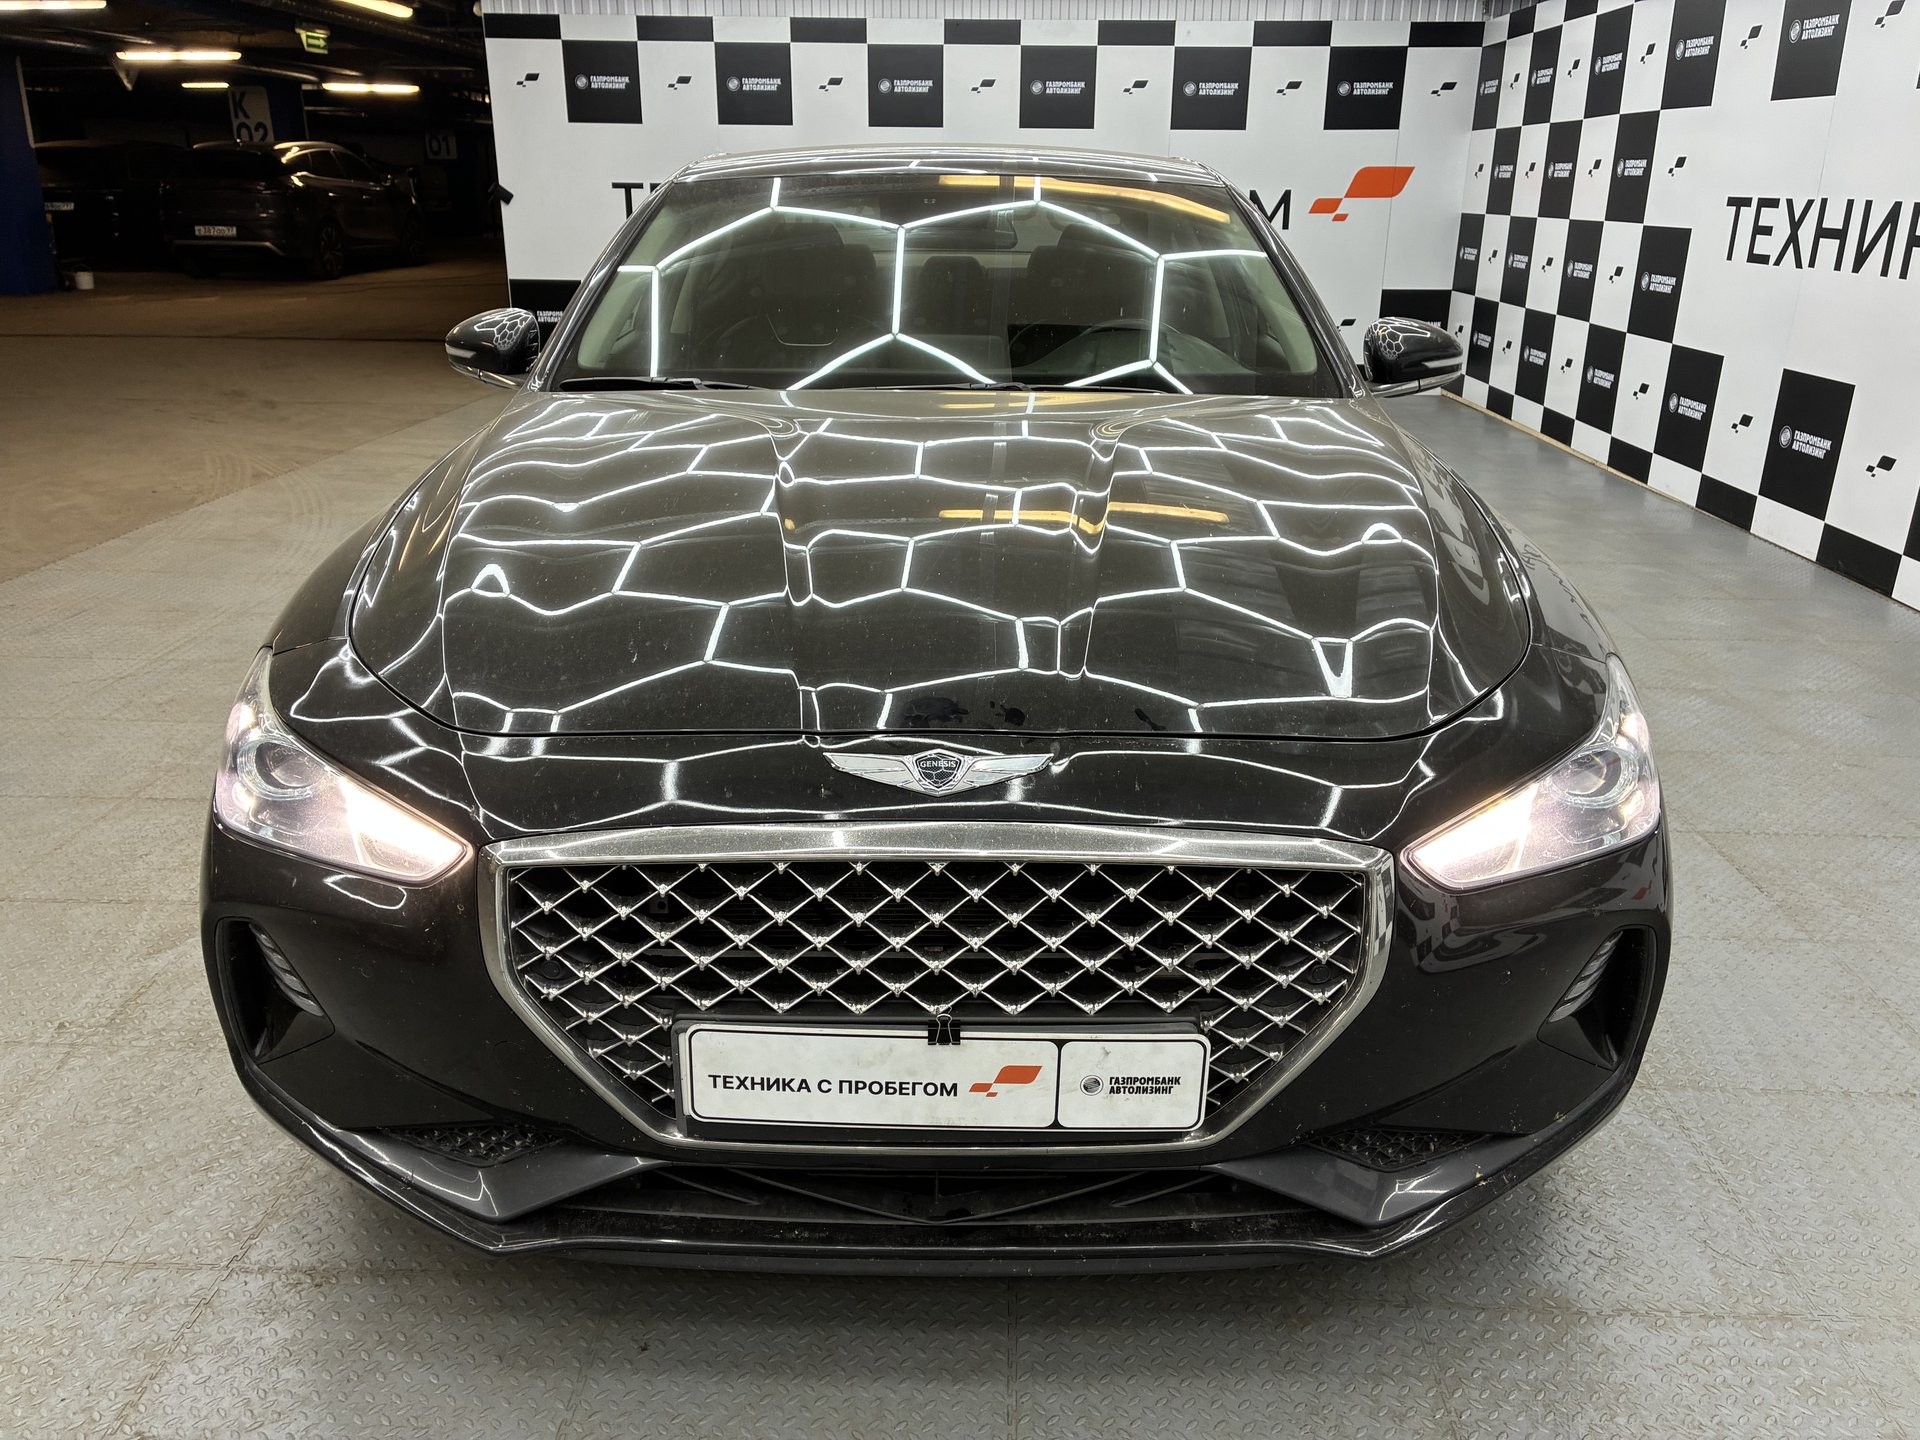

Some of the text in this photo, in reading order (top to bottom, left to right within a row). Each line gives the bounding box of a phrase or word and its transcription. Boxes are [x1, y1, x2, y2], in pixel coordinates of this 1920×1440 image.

[1803, 14, 1840, 29] ГАЗПРОМБАНК
[1802, 26, 1834, 40] АВТОЛИЗИНГ
[1686, 36, 1714, 48] ГАЗПРОМБАНК
[1685, 46, 1710, 57] АВТОЛИЗИНГ
[590, 75, 630, 83] ГАЗПРОМБАНК
[742, 77, 781, 85] ГАЗПРОМБАНК
[894, 79, 933, 87] ГАЗПРОМБАНК
[1045, 80, 1085, 88] ГАЗПРОМБАНК
[1353, 81, 1393, 89] ГАЗПРОМБАНК
[1680, 397, 1707, 413] ГАЗПРОМБАНК
[1678, 405, 1703, 421] АВТОЛИЗИНГ
[1794, 430, 1832, 451] ГАЗПРОМБАНК
[1792, 440, 1827, 460] АВТОЛИЗИНГ
[920, 760, 956, 768] GENESIS
[708, 1074, 958, 1097] ТЕХНИКА С ПРОБЕГОМ
[1109, 1076, 1181, 1086] ГАЗПРОМБАНК
[1109, 1086, 1174, 1095] АВТОЛИЗИНГ
